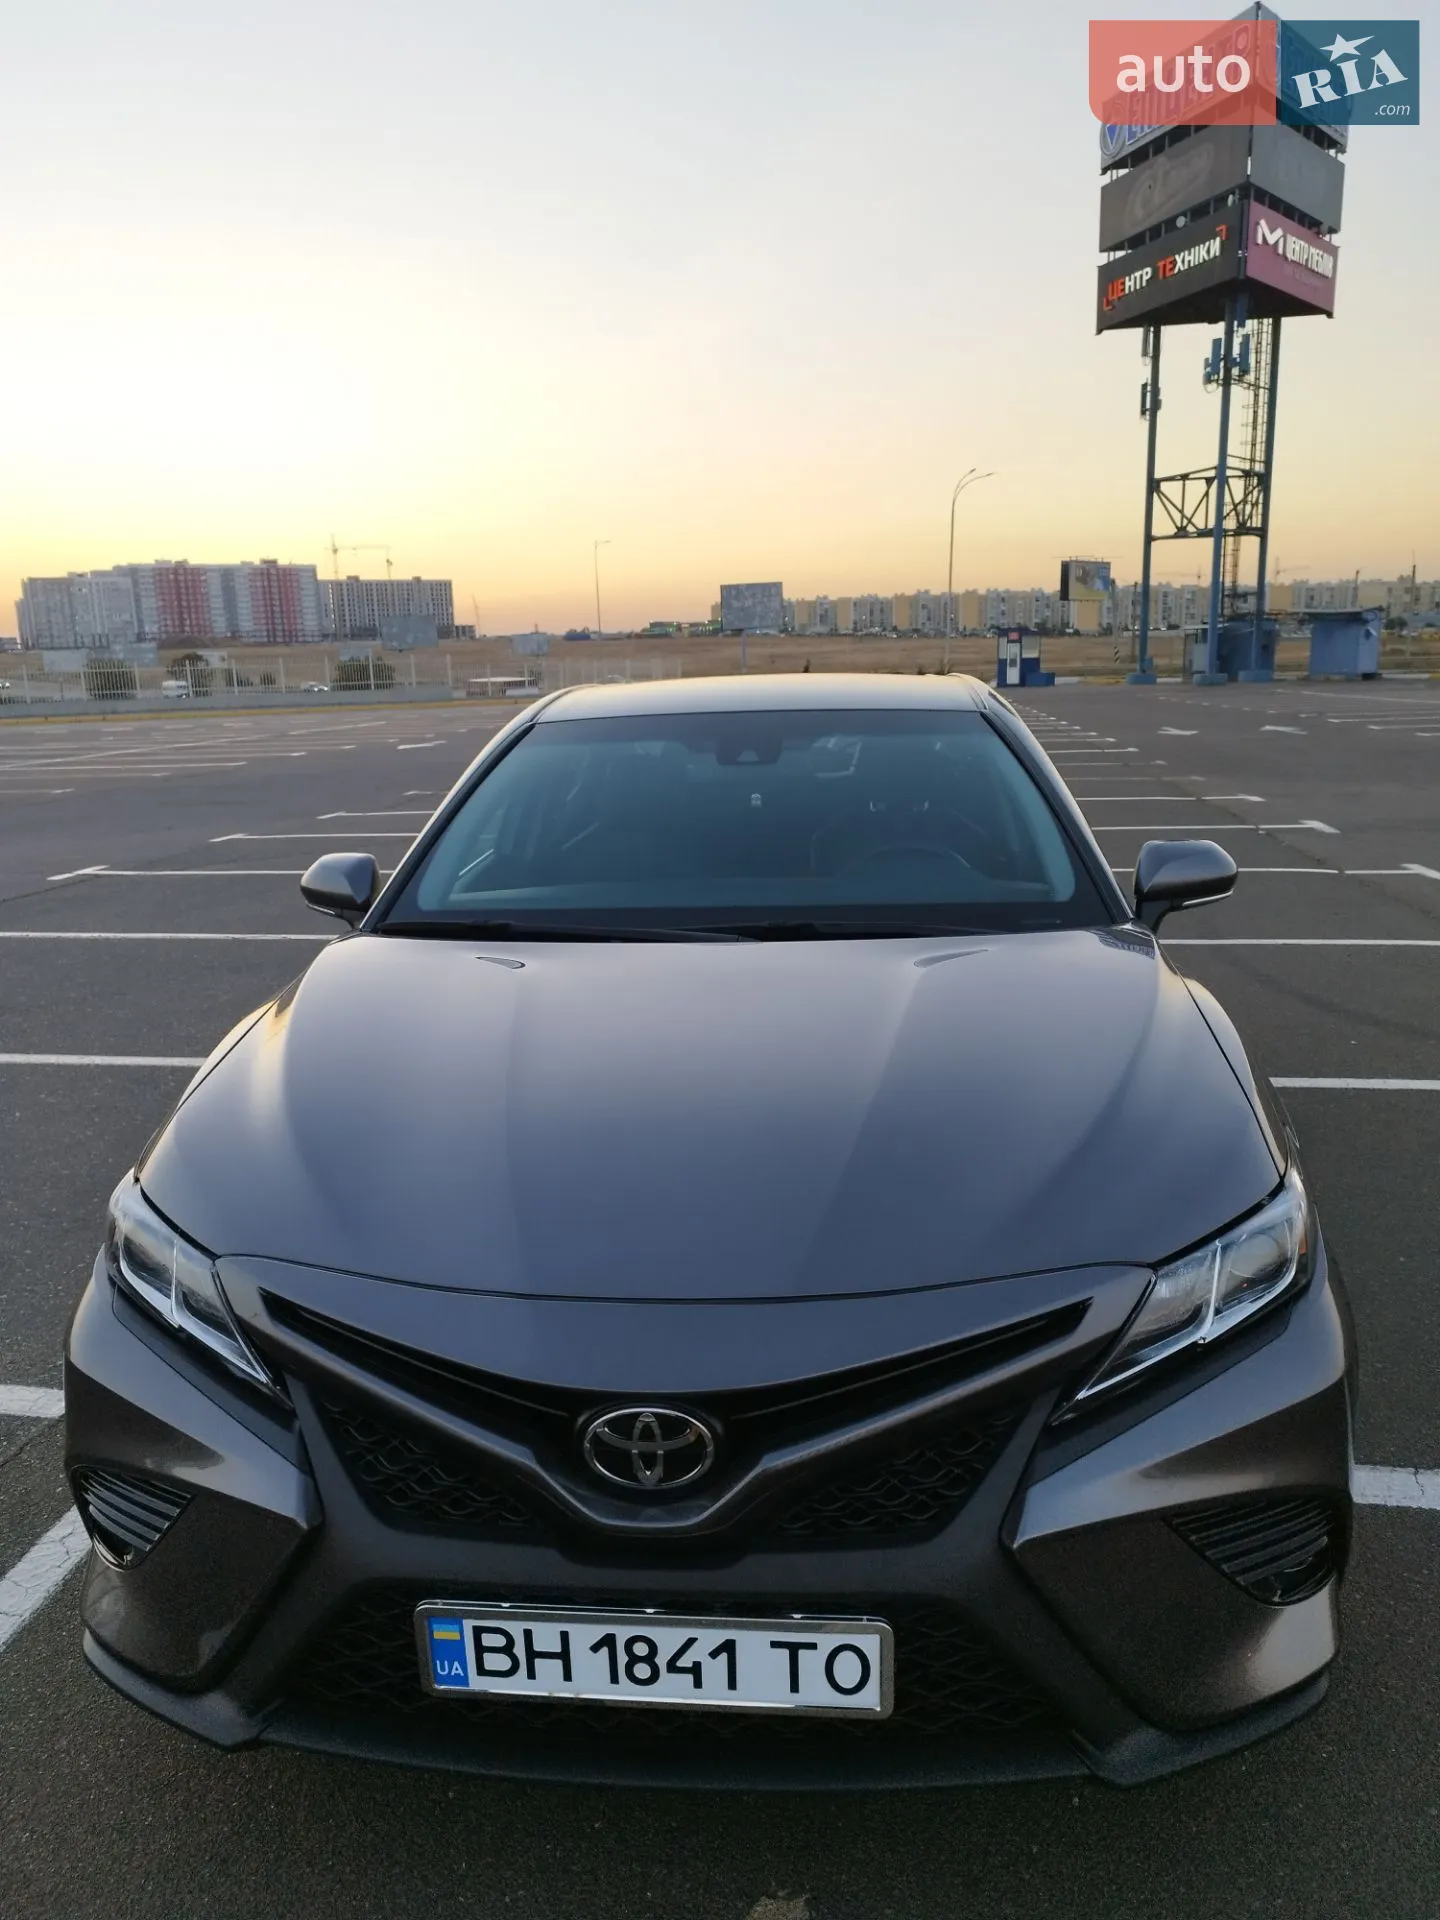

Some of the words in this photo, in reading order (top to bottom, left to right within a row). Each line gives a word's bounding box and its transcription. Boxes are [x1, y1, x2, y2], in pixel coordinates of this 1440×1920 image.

[1108, 266, 1152, 301] ЦЕНТР
[1156, 236, 1221, 280] ТЕХНІКИ
[436, 1659, 464, 1678] UA
[471, 1624, 573, 1682] BH
[589, 1632, 738, 1691] 1841
[769, 1640, 871, 1696] TO
